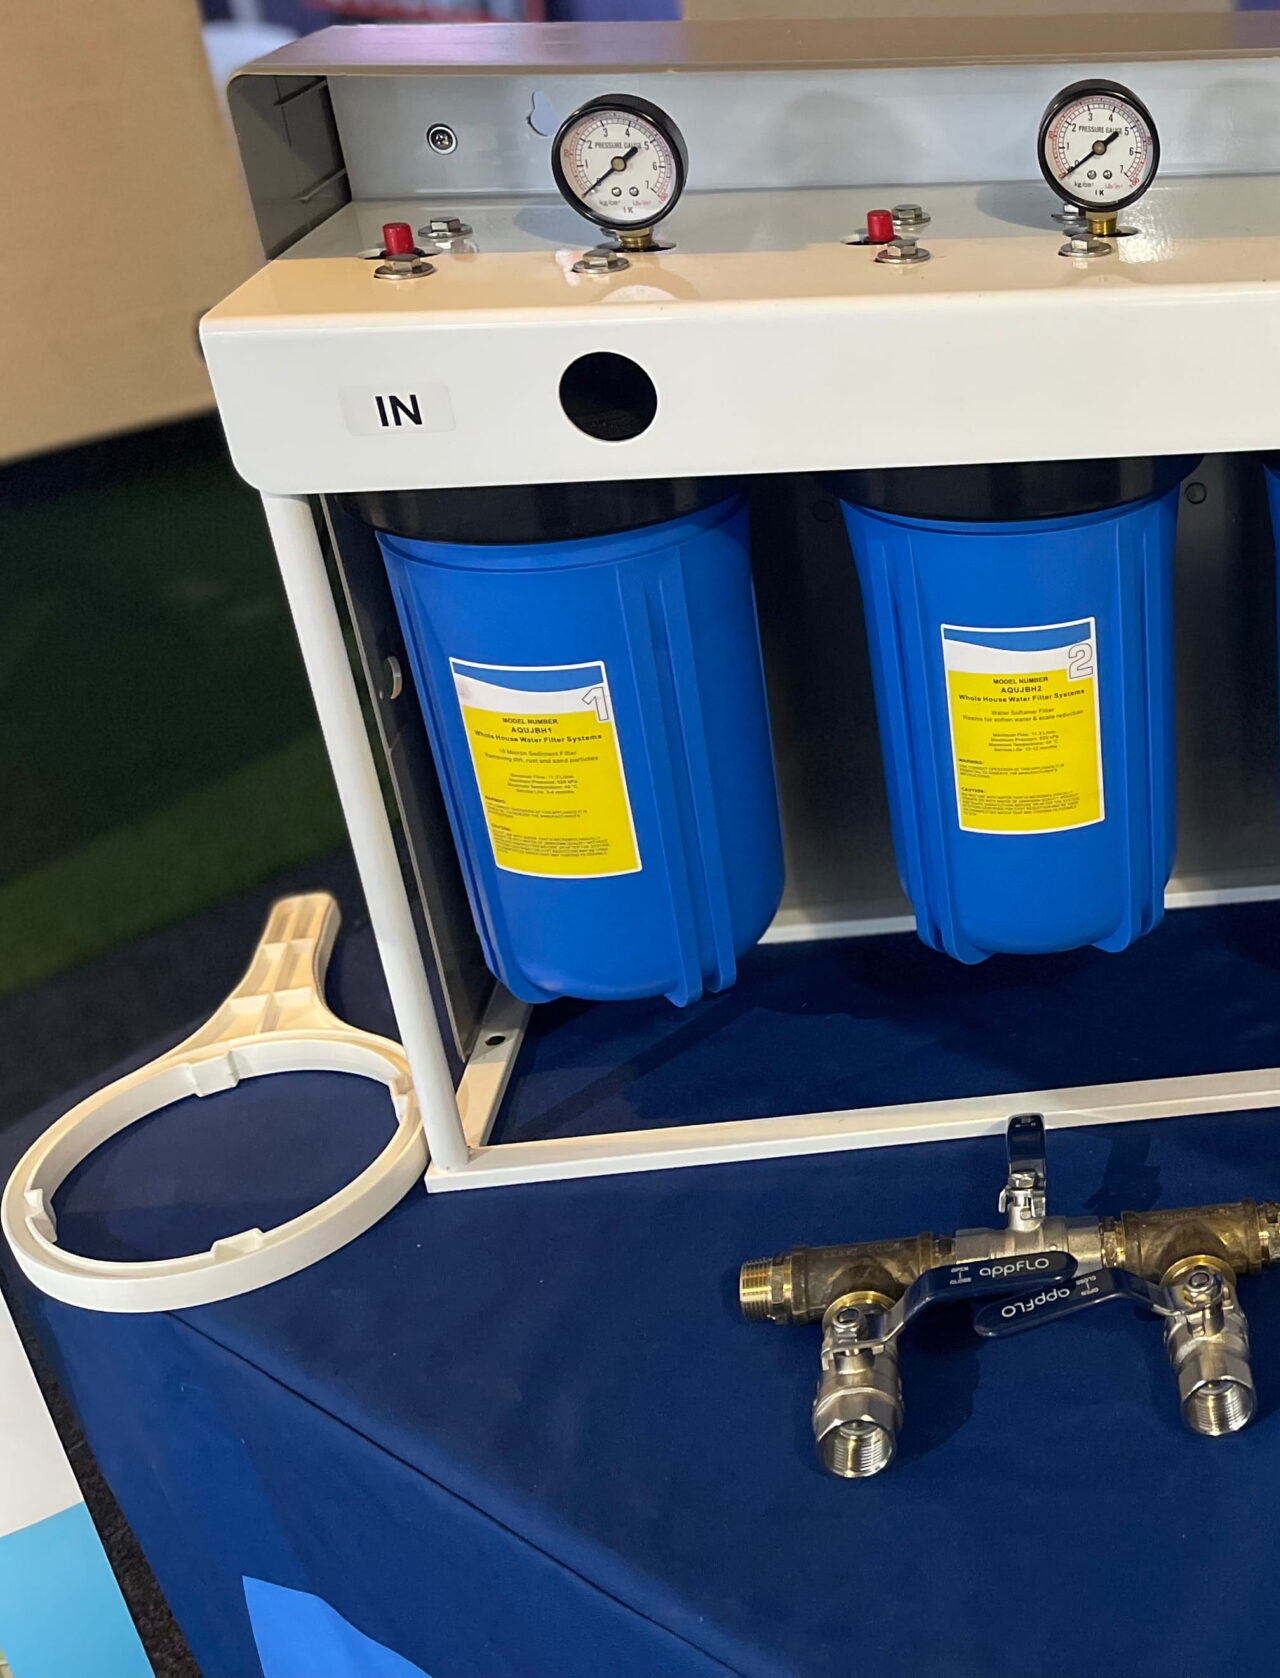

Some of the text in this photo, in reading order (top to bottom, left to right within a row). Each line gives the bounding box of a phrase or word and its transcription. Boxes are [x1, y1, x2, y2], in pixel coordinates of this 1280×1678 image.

[1088, 113, 1092, 121] 3
[1109, 114, 1113, 122] 4
[1072, 124, 1076, 132] 2
[1125, 127, 1129, 135] 5
[1129, 147, 1134, 156] 6
[1120, 165, 1124, 173] 7
[375, 395, 422, 426] IN
[1068, 643, 1094, 679] 2
[958, 694, 981, 702] Whole
[1032, 693, 1052, 701] Filter
[1054, 688, 1085, 699] Systems
[581, 686, 609, 721] 1
[475, 730, 495, 739] Whole
[496, 734, 519, 742] House
[567, 733, 602, 742] Systems
[979, 1258, 1049, 1277] appFLO
[950, 1277, 971, 1285] CLOSE
[1076, 1276, 1096, 1285] CLOSE
[1001, 1289, 1070, 1317] appFLO
